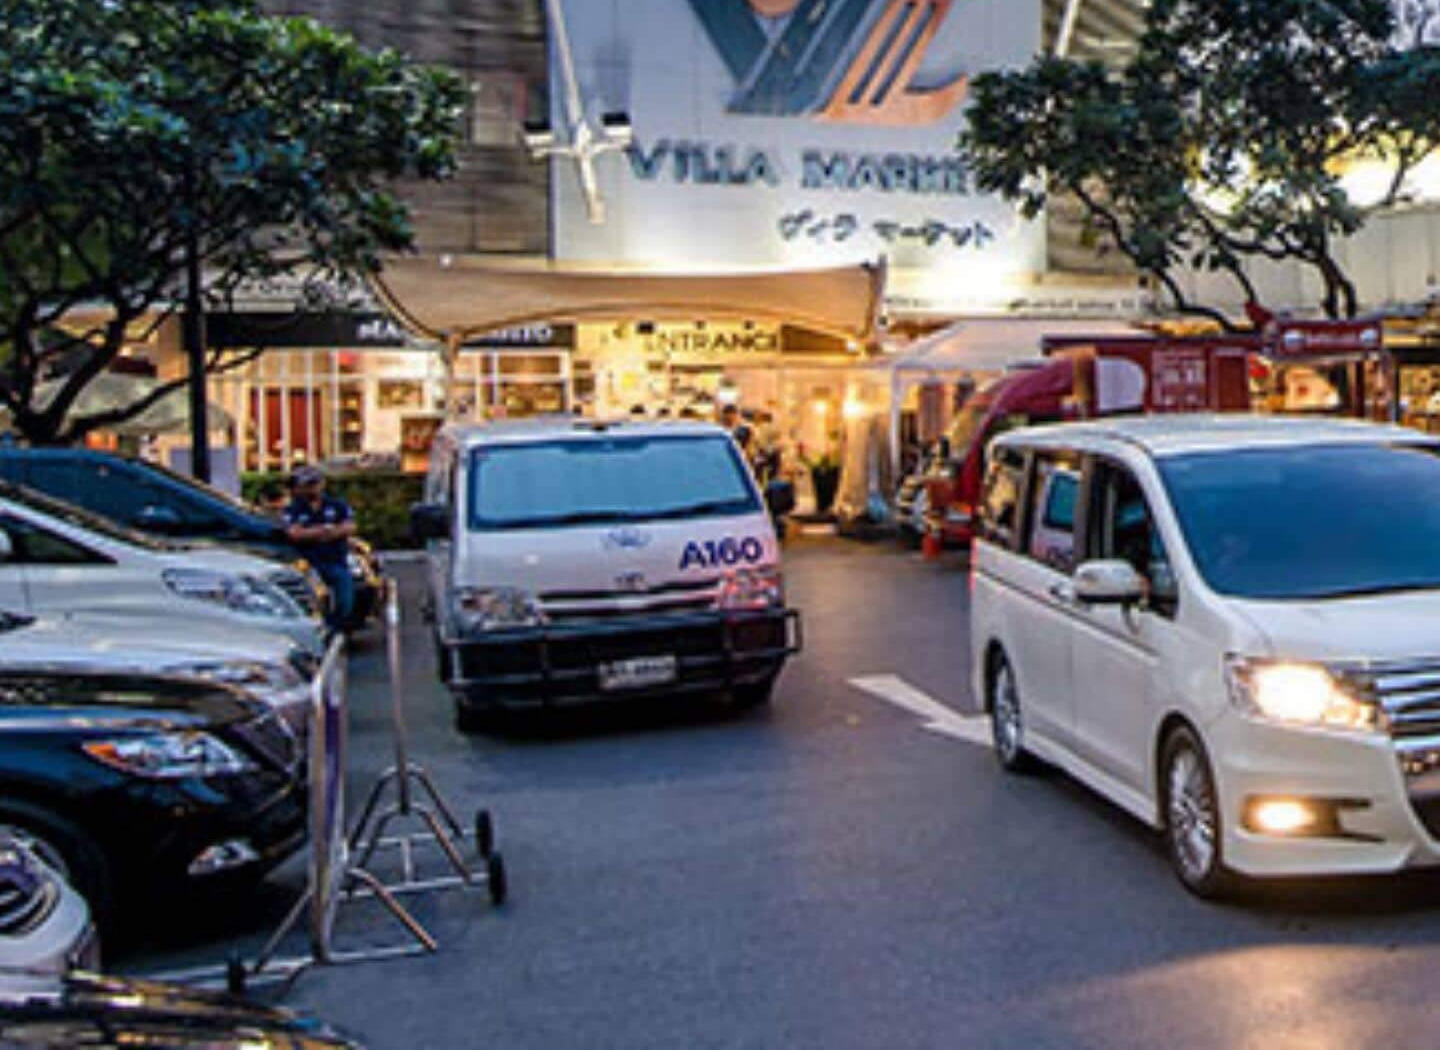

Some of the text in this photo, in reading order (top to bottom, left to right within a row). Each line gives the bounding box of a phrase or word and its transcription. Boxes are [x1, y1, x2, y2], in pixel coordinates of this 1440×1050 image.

[626, 139, 988, 196] VILLA MARKE
[678, 535, 765, 571] A160
